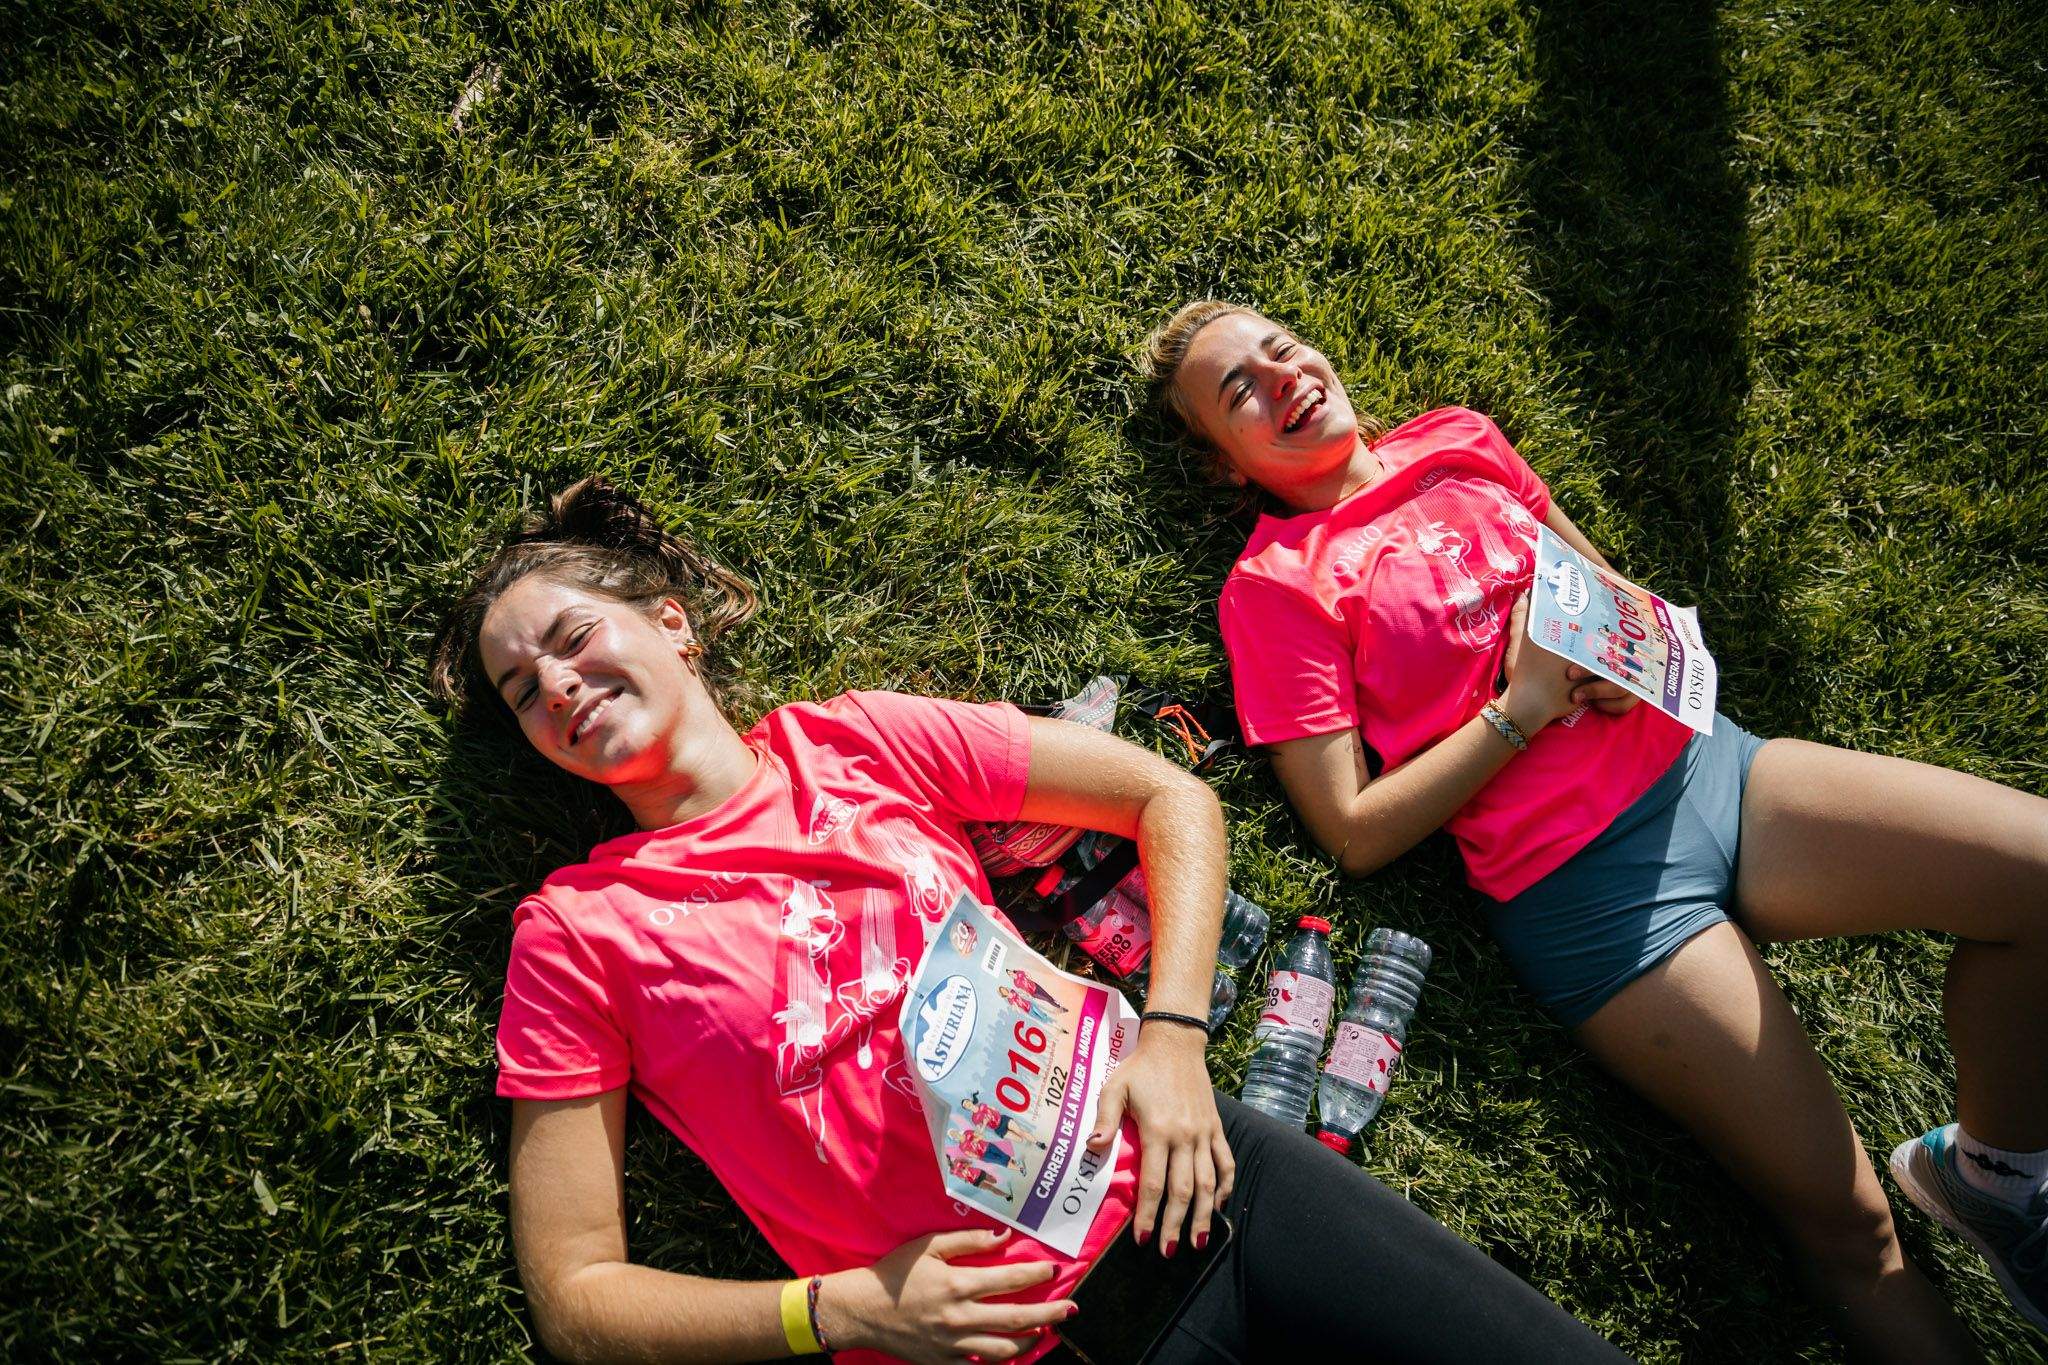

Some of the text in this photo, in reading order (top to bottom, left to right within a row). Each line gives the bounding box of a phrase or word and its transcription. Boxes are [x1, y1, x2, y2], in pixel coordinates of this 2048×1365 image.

[1332, 525, 1383, 577] OYSHO
[1614, 595, 1647, 641] 016
[1672, 648, 1681, 659] DE
[1667, 661, 1681, 697] CARRERA
[1688, 659, 1705, 710] OYSHO
[923, 985, 972, 1077] ASTURIANA
[1078, 1015, 1096, 1059] MADRID
[995, 1020, 1047, 1113] 016
[1045, 1066, 1068, 1108] 1022
[1070, 1063, 1088, 1102] MUJER
[1060, 1116, 1076, 1139] DE
[1065, 1099, 1081, 1122] LA
[1036, 1141, 1071, 1199] CARRERA
[1062, 1148, 1102, 1216] OYSH
